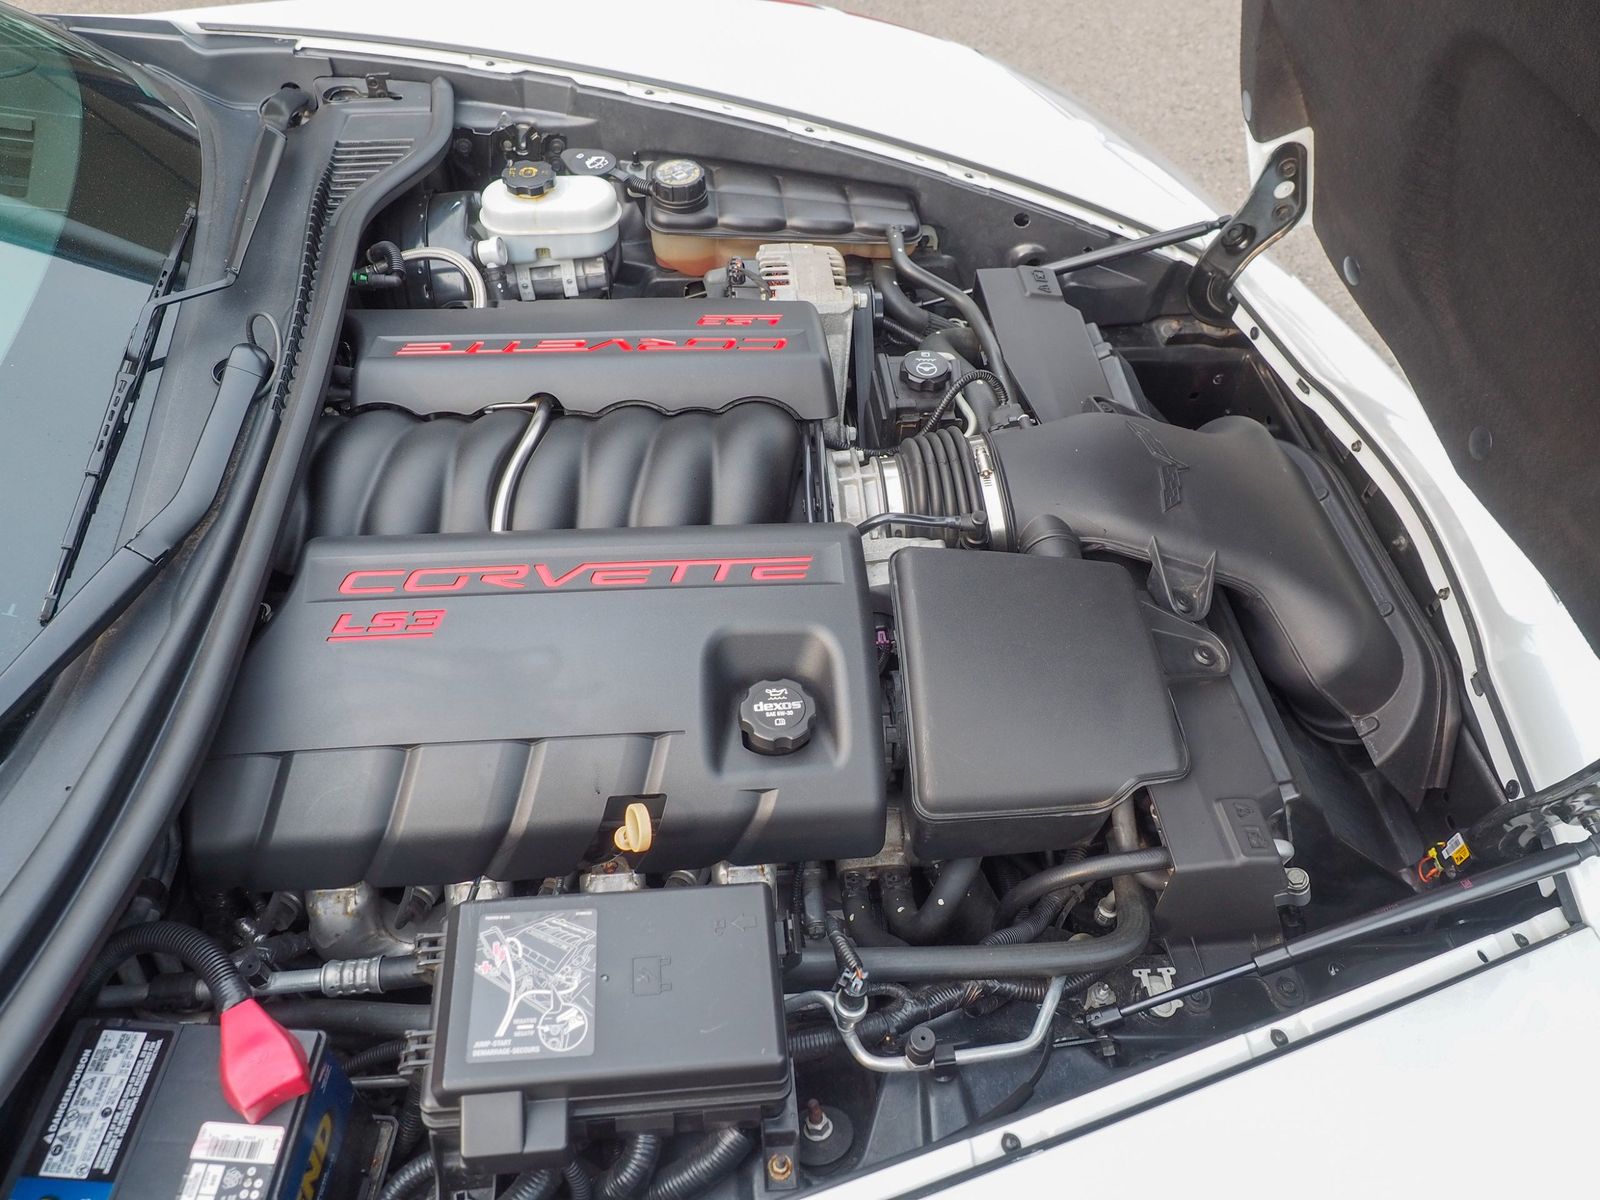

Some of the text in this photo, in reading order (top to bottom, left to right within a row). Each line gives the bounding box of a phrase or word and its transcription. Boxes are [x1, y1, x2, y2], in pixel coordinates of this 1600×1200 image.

[697, 315, 784, 326] LS3
[395, 338, 788, 355] CORVETTE
[338, 556, 813, 593] CORVETTE
[329, 609, 446, 638] LS3
[754, 702, 801, 711] dexos
[49, 1048, 92, 1131] DANGER/POISON
